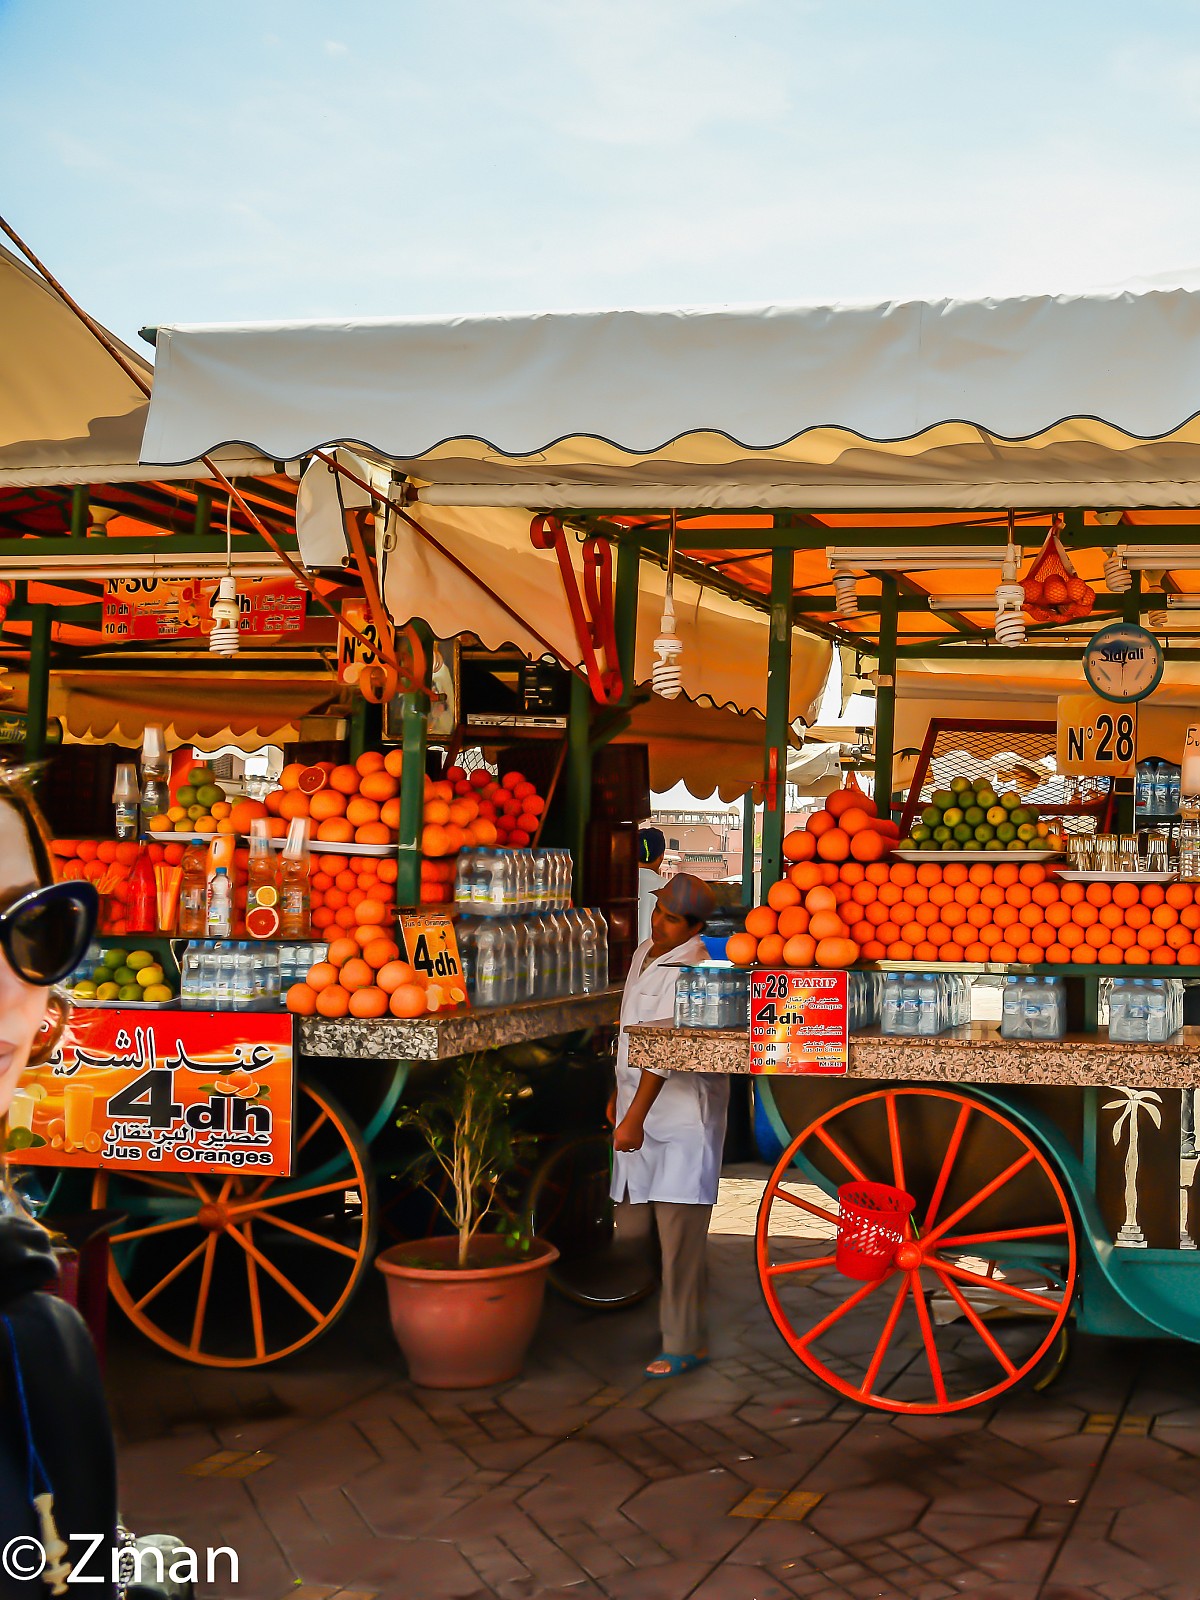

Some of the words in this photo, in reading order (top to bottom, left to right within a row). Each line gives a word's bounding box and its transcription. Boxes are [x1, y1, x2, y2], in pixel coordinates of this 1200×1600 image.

[105, 604, 117, 615] 10
[118, 603, 128, 615] dh
[105, 623, 116, 634] 10
[117, 622, 128, 634] dh
[240, 618, 250, 630] dh
[1068, 714, 1134, 762] N°28
[414, 934, 458, 978] 4dh
[753, 975, 788, 998] N°28
[792, 978, 837, 988] TARIF
[756, 1003, 804, 1025] 4dh
[754, 1027, 764, 1035] 10
[766, 1027, 777, 1035] dh
[166, 1039, 274, 1073] عند
[753, 1044, 763, 1052] 10
[765, 1043, 776, 1052] dh
[753, 1058, 762, 1066] 10
[765, 1058, 776, 1066] dh
[107, 1070, 273, 1132] 4dh
[104, 1122, 195, 1146] البرتقال
[199, 1131, 271, 1147] عصير
[103, 1146, 141, 1160] Jus
[176, 1147, 273, 1168] Oranges
